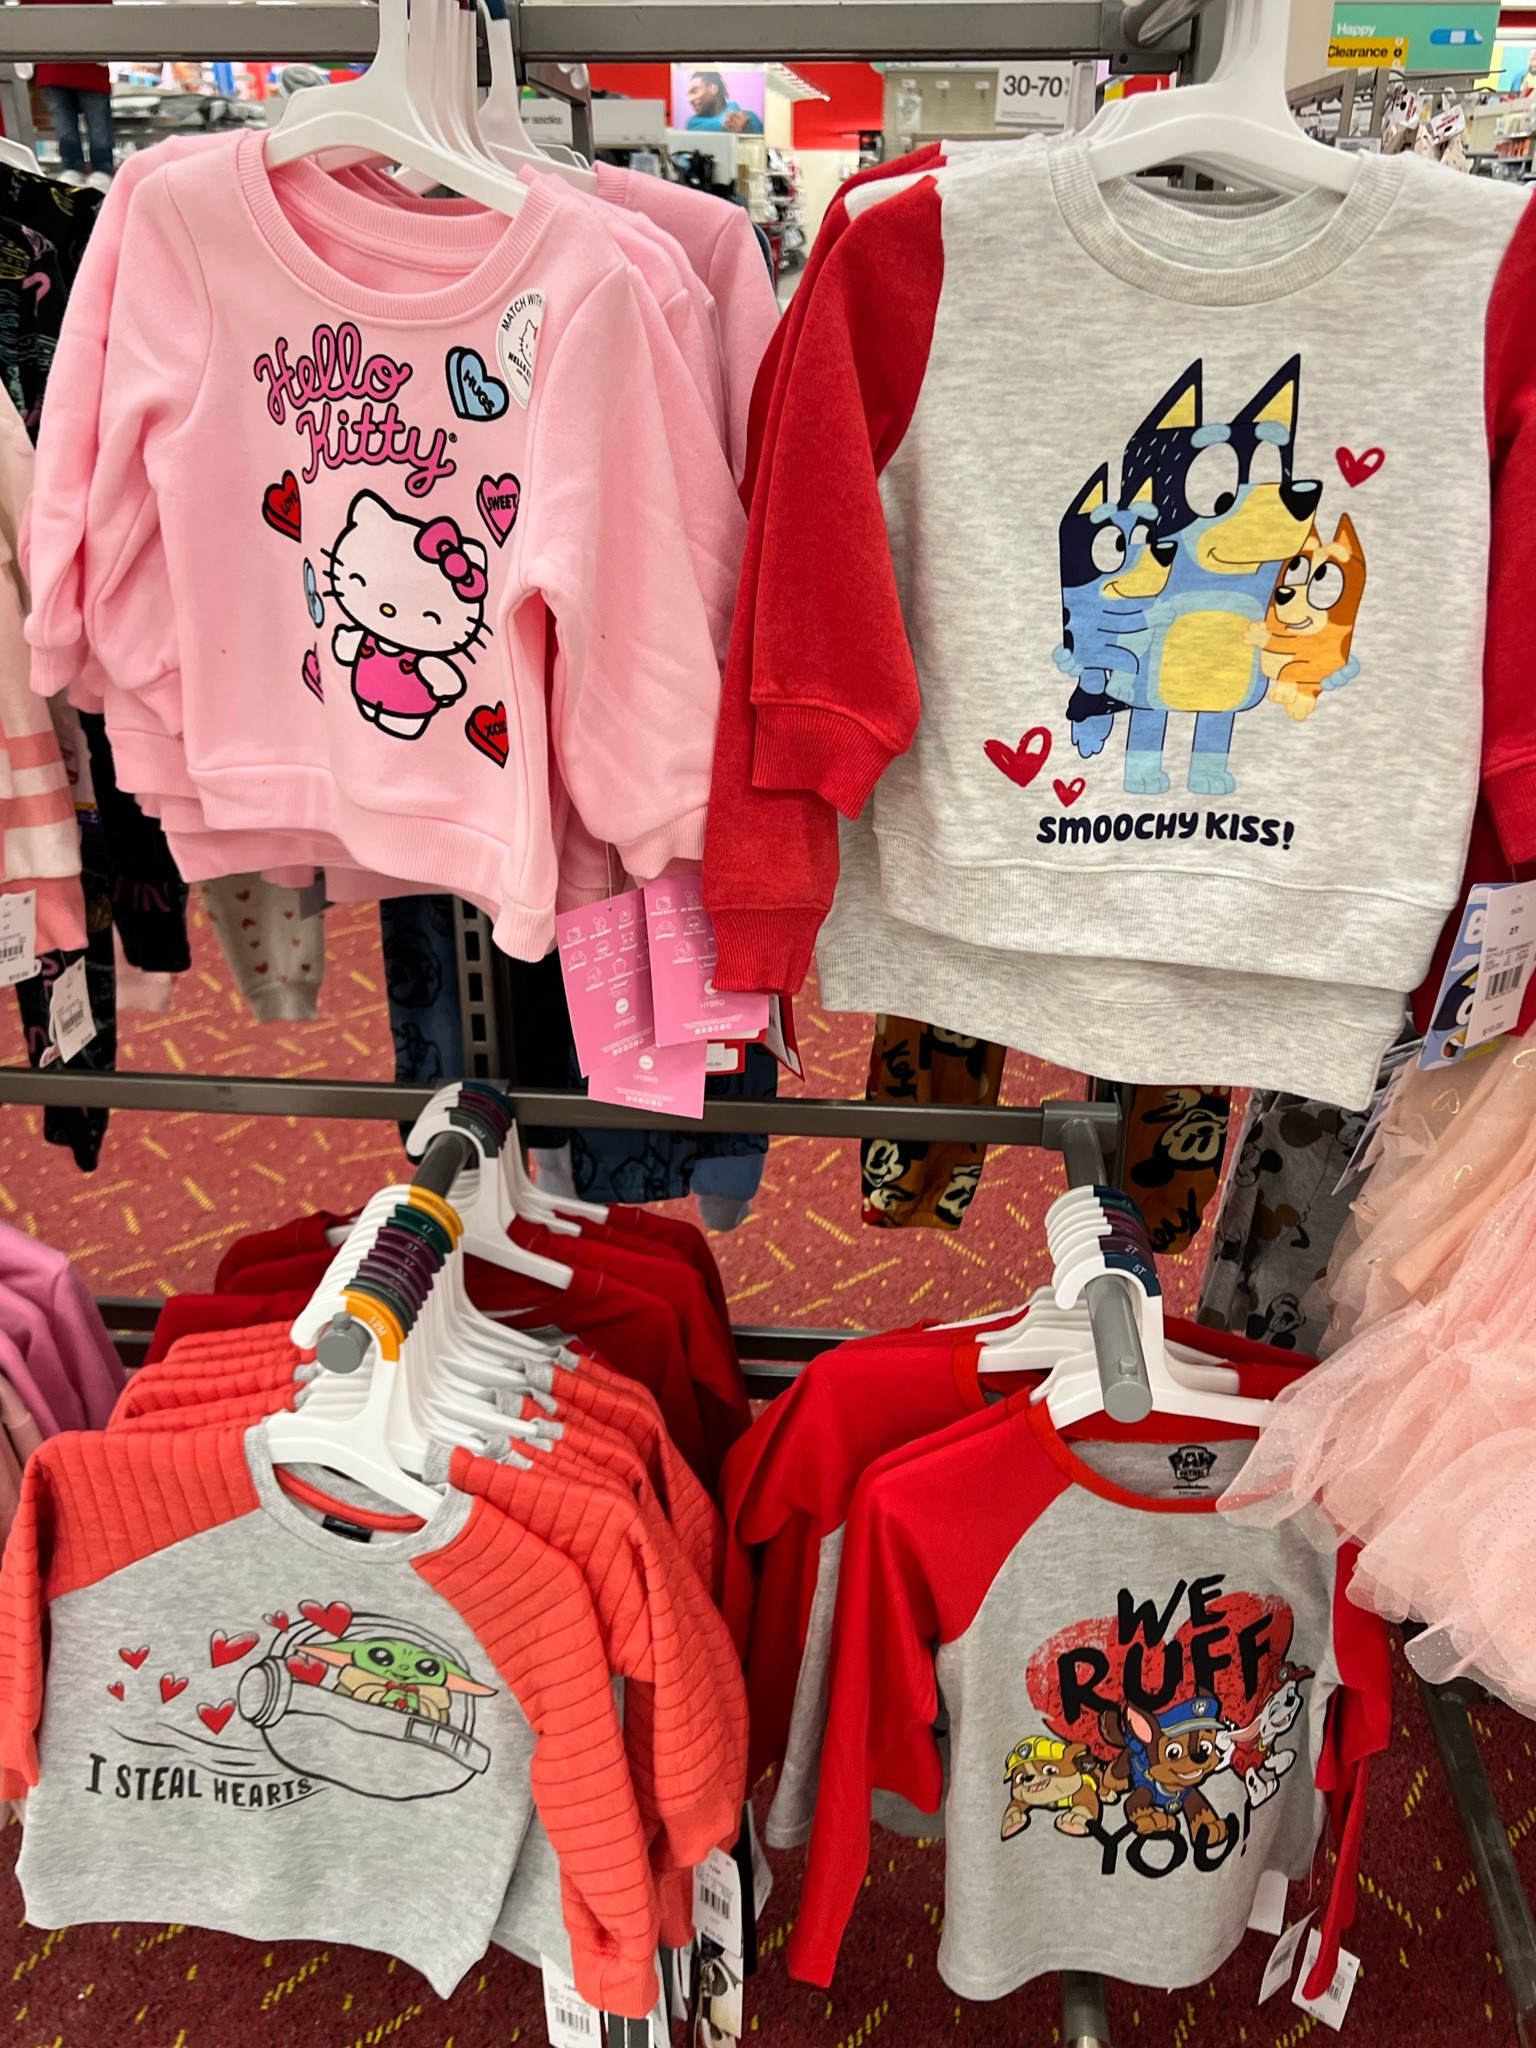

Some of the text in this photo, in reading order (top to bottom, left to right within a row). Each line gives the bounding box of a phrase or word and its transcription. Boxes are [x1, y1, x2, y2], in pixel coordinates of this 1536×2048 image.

[1336, 22, 1377, 38] Happy
[1328, 45, 1389, 58] Clearance
[501, 296, 527, 332] MATCH
[254, 322, 413, 425] Hello
[508, 352, 527, 373] HELLO
[463, 369, 496, 416] HUGS
[296, 401, 457, 498] Kitty
[487, 493, 518, 512] SWEET
[1036, 811, 1295, 851] SMOOCHY KISS!
[1124, 1243, 1139, 1256] 2T
[1132, 1263, 1148, 1276] 5T
[369, 1315, 388, 1337] 12M
[1117, 1574, 1226, 1648] WE
[1057, 1612, 1274, 1726] RUFF
[86, 1753, 313, 1807] I STEAL HEARTS
